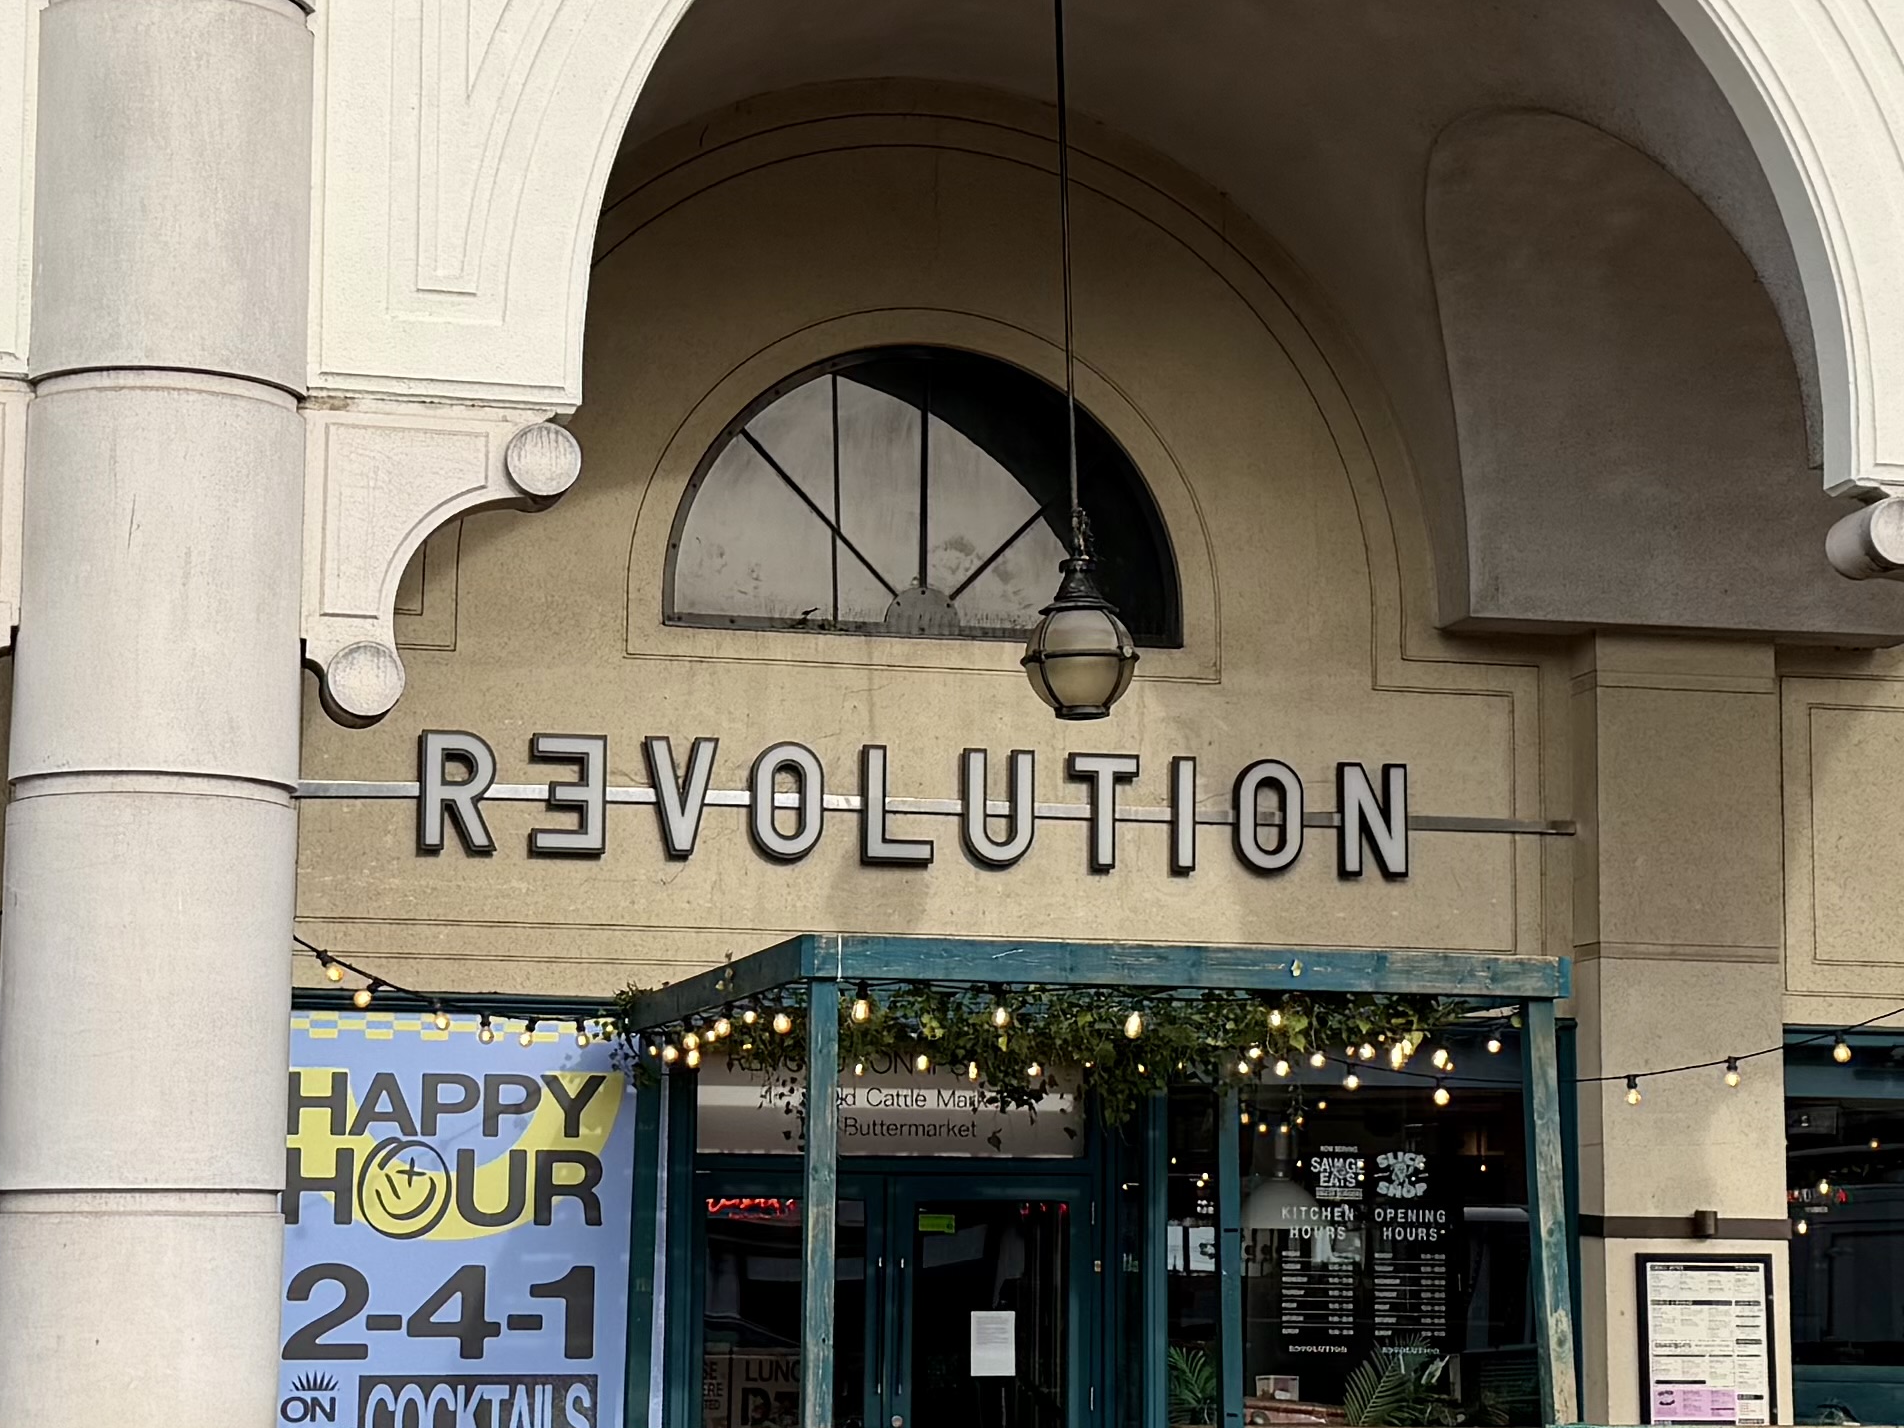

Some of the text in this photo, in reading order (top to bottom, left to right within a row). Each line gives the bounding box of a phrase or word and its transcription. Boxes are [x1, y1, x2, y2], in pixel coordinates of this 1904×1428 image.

[418, 730, 1409, 879] REVOLUTION
[288, 1071, 608, 1138] HAPPY
[866, 1087, 927, 1108] Cattle
[844, 1116, 977, 1138] Buttermarket
[281, 1137, 604, 1239] HOUR
[1281, 1205, 1355, 1221] KITCHEN
[1374, 1208, 1446, 1223] OPENING
[1289, 1225, 1347, 1240] HOURS
[1383, 1227, 1439, 1241] HOURS
[281, 1262, 596, 1360] 2-4-1
[280, 1396, 336, 1423] ON
